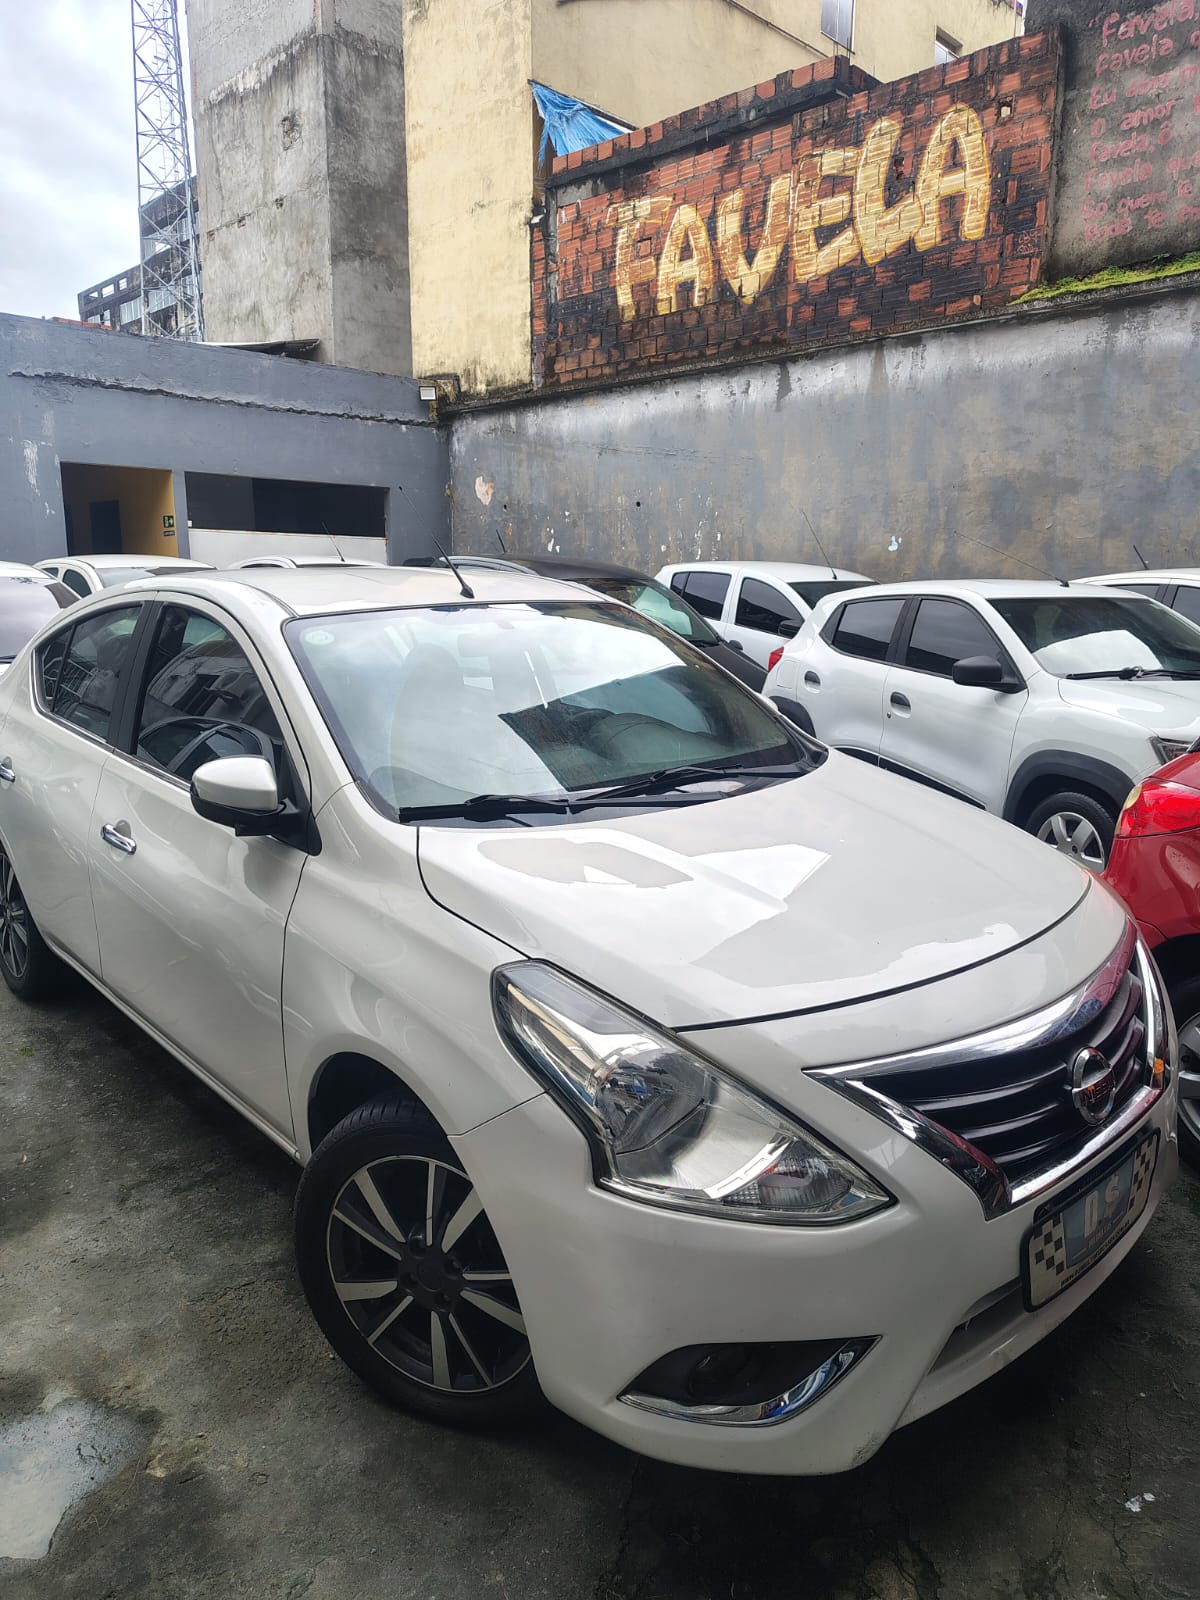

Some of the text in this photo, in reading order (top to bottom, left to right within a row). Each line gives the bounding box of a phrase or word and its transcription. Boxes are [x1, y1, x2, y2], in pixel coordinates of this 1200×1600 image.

[1095, 34, 1174, 77] favela
[1089, 86, 1117, 109] Eu
[1120, 99, 1178, 130] amor
[606, 102, 991, 321] FAVELA
